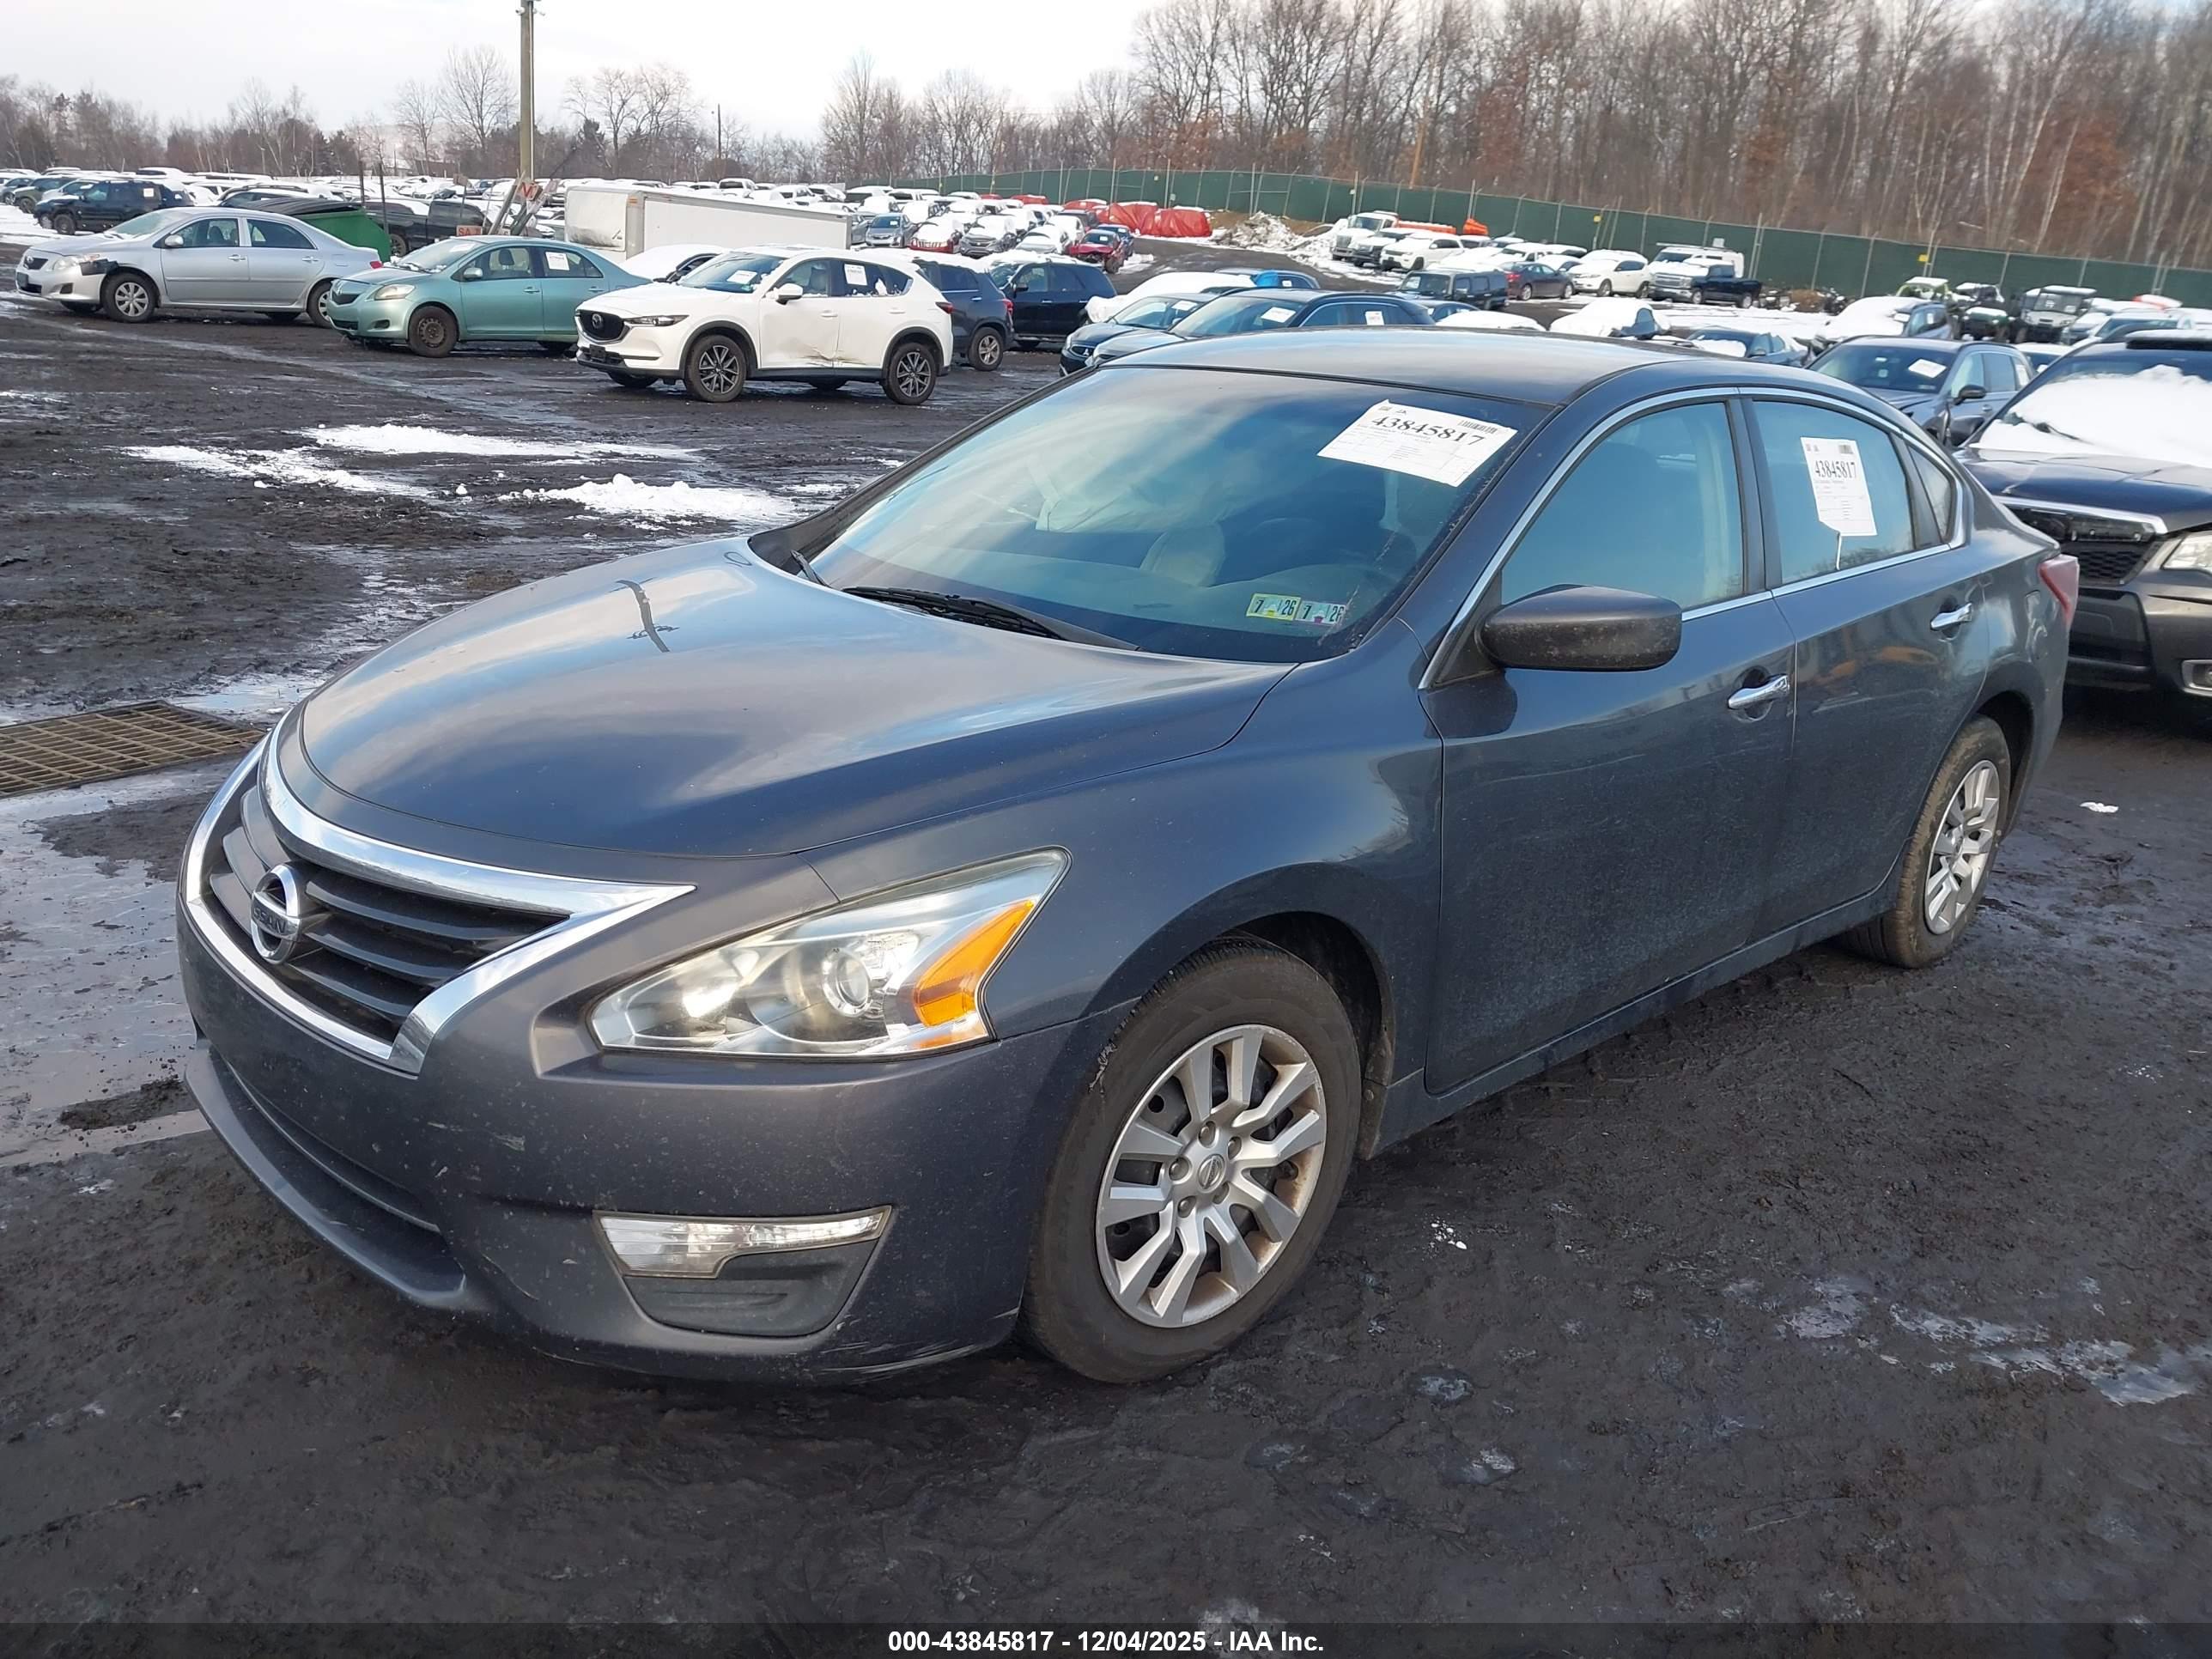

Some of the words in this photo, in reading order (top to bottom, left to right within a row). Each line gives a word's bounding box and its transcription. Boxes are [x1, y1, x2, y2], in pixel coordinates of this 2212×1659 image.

[1371, 416, 1486, 446] 43845817
[1814, 460, 1856, 478] 43845817
[1255, 599, 1264, 613] 7
[1281, 599, 1297, 616] 26
[1303, 605, 1312, 619] 7
[252, 907, 288, 934] SSAN
